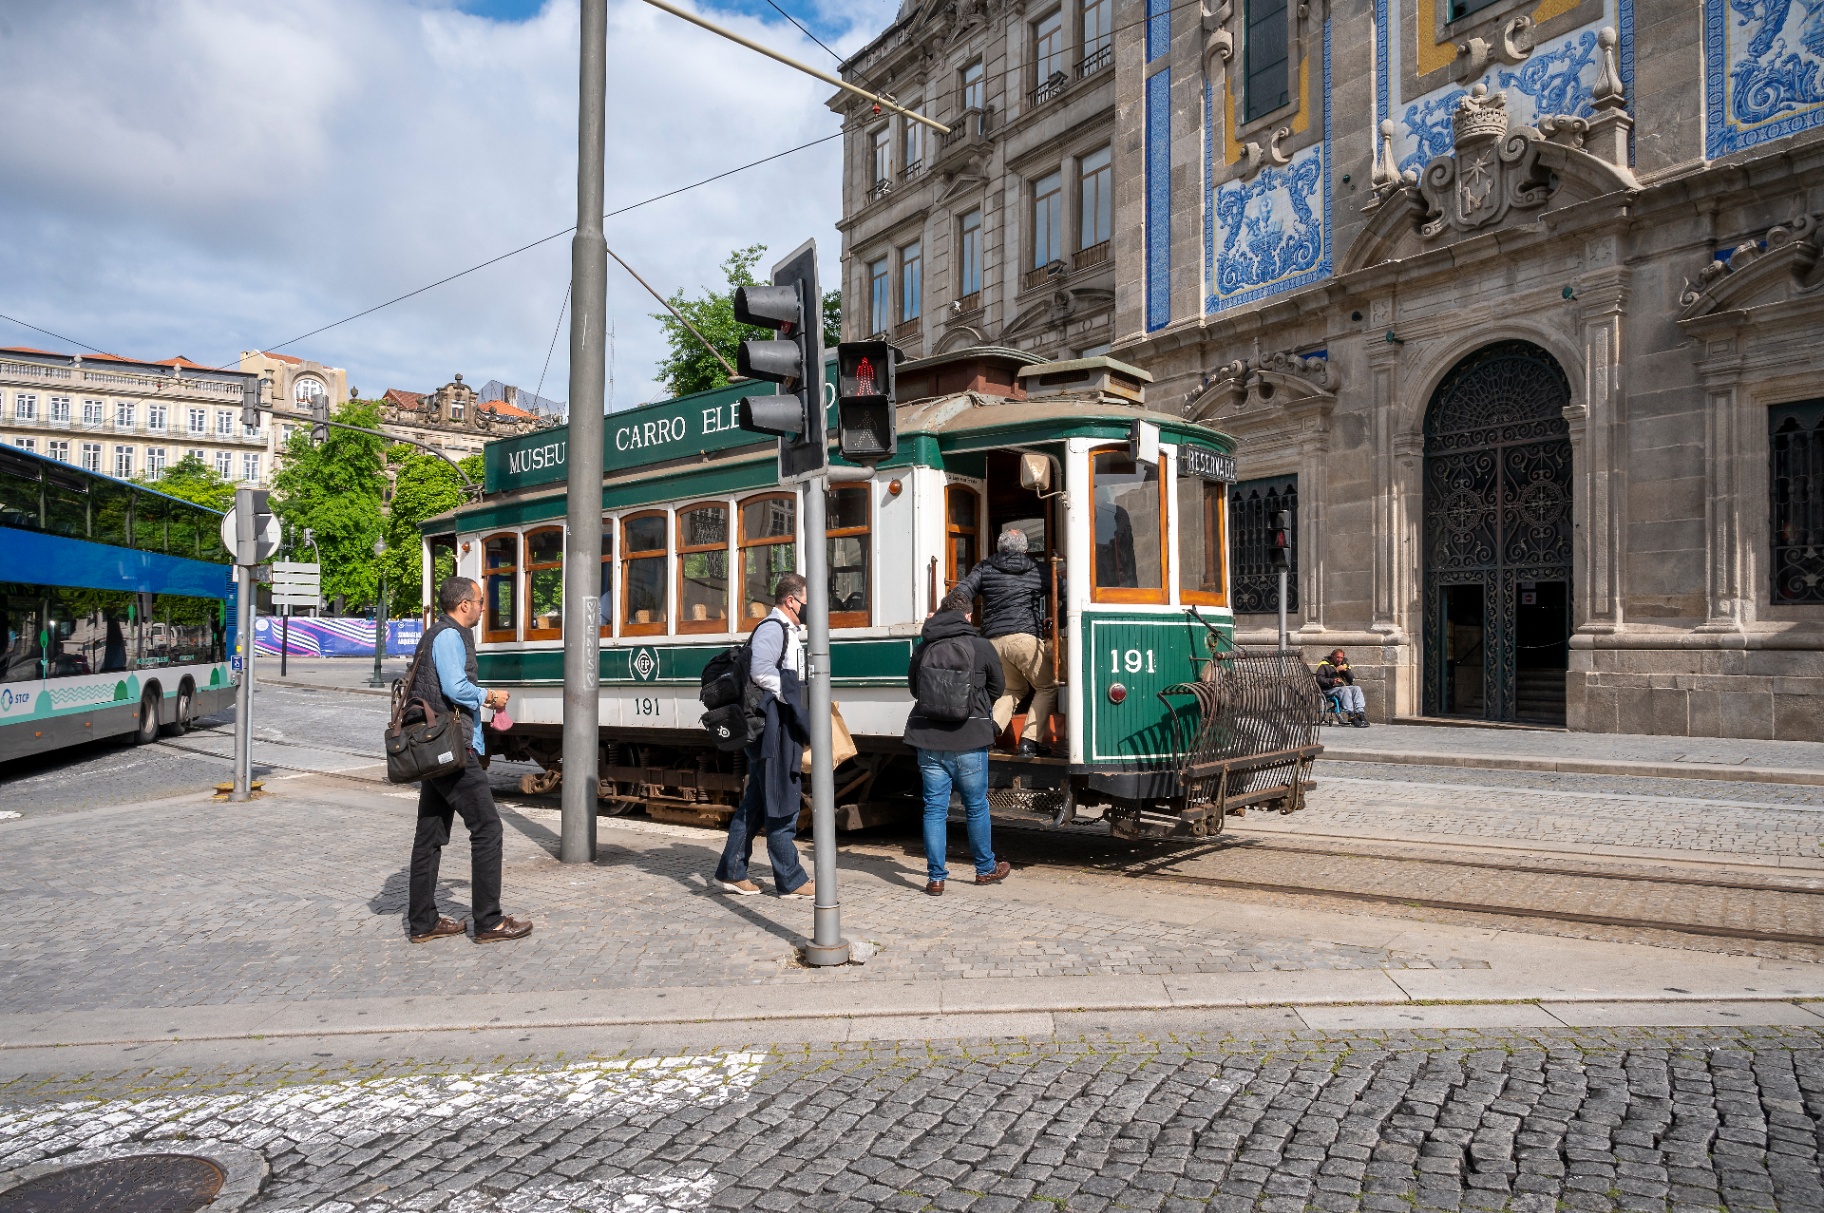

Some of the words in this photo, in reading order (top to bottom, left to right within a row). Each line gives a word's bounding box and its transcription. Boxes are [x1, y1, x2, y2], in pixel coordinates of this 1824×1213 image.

[509, 442, 565, 474] MUSEU
[616, 416, 686, 451] CARRO
[587, 613, 595, 669] VENUS
[1110, 649, 1155, 674] 191
[15, 693, 30, 704] STCP
[635, 697, 660, 716] 191
